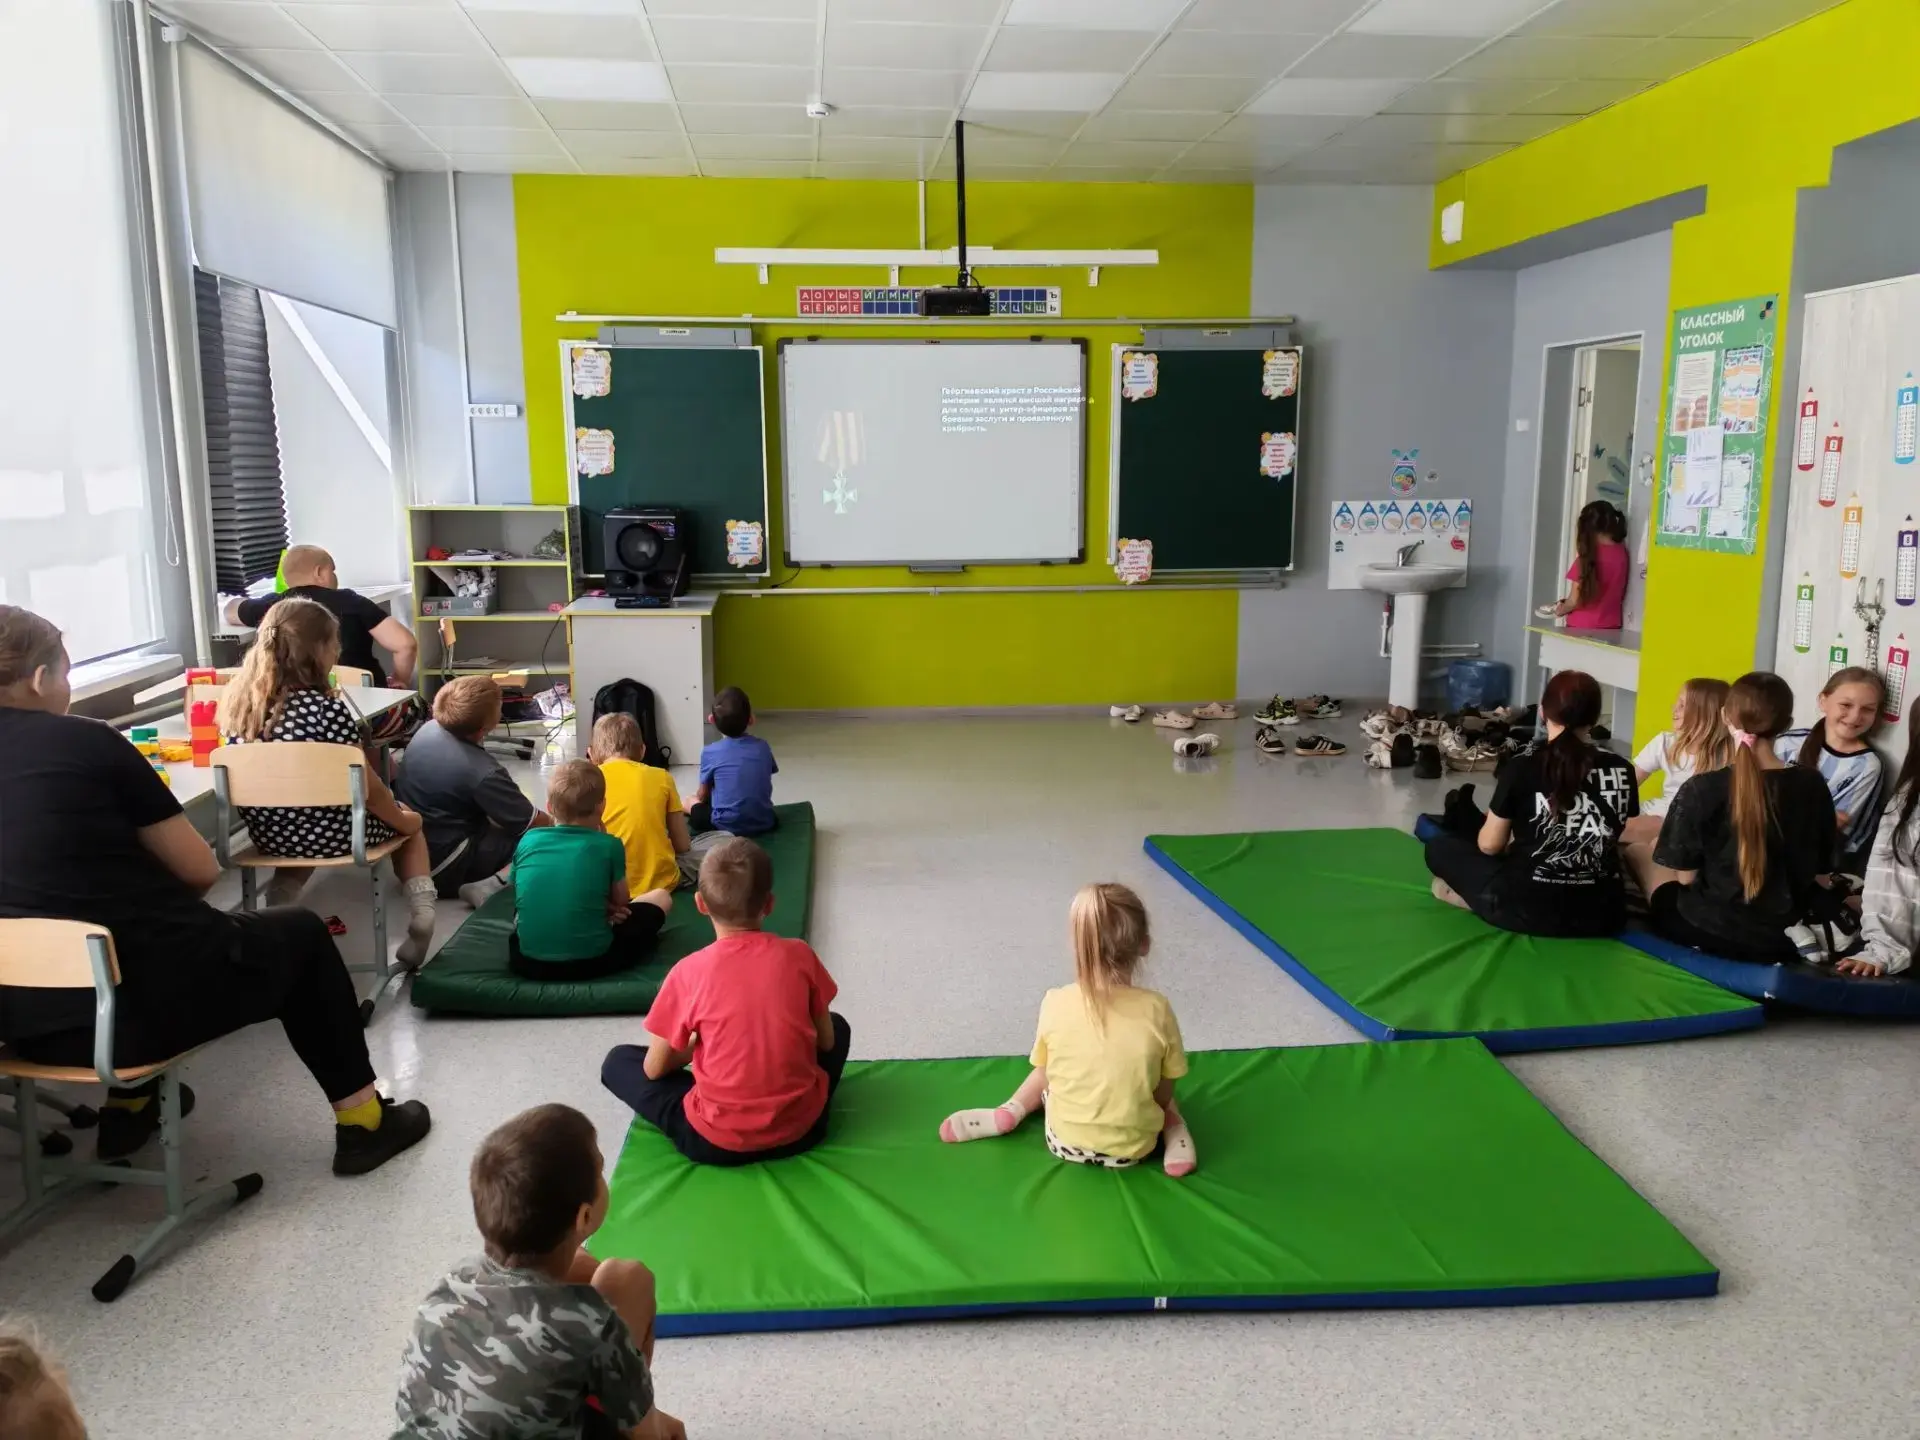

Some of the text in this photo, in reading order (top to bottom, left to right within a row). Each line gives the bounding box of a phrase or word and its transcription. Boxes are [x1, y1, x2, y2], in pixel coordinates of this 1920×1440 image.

[1680, 305, 1745, 330] КЛАССНЫЙ
[1679, 331, 1724, 349] УГОЛОК
[974, 416, 1008, 424] заслуги
